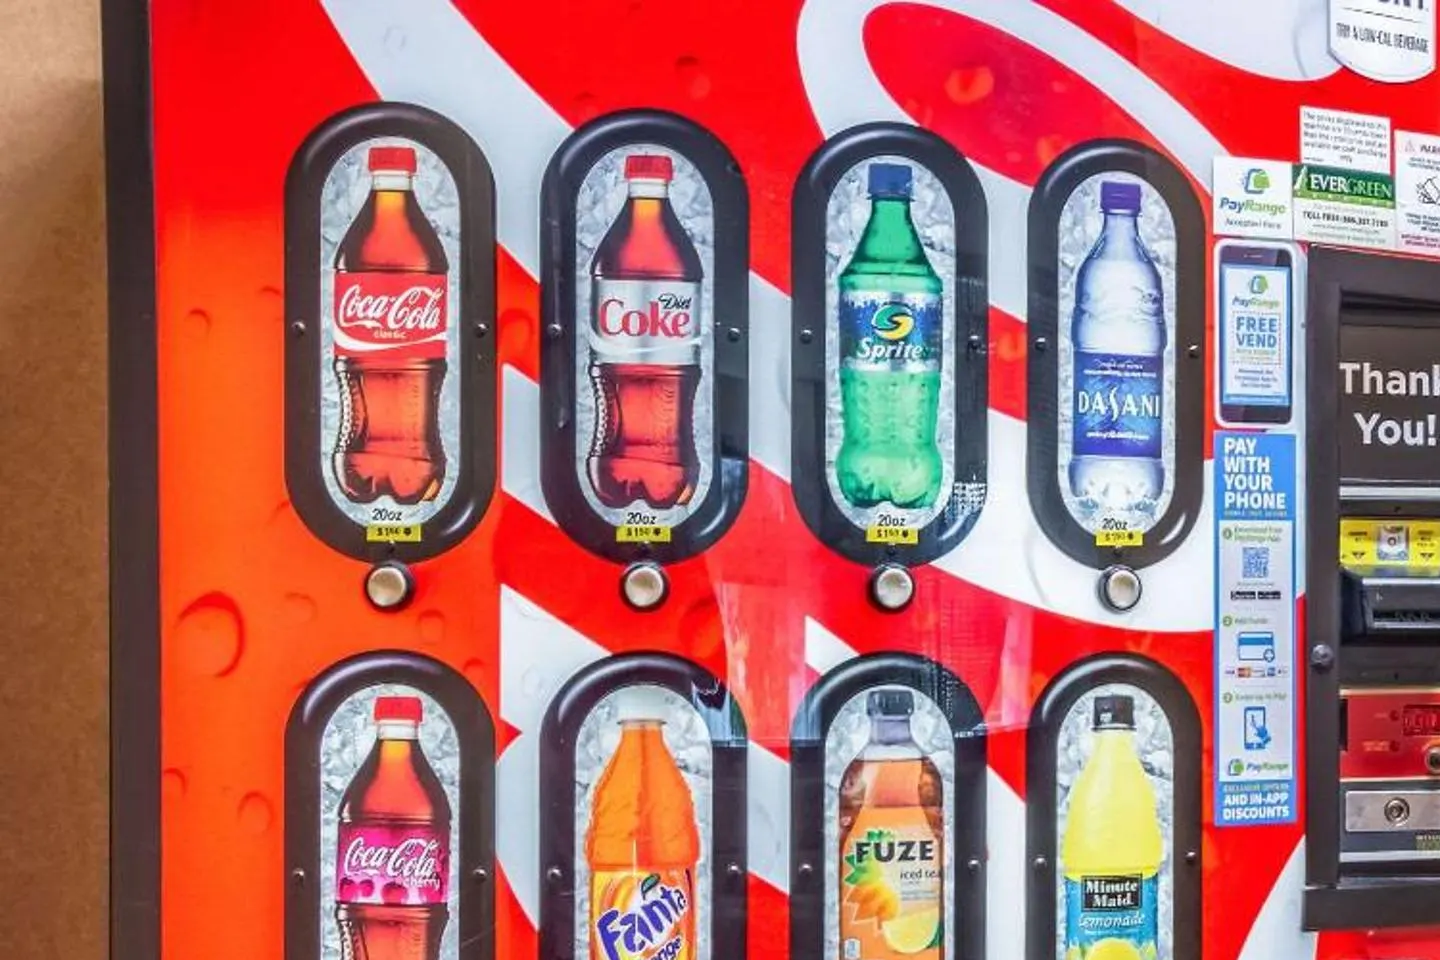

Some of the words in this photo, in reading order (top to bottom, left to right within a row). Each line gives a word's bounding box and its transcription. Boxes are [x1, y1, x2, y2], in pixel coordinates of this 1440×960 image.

[1393, 34, 1429, 53] BEVERAGE
[1310, 173, 1392, 198] EVERGREEN
[1219, 196, 1286, 215] PayRange
[339, 284, 444, 329] Coca-Cola
[658, 292, 692, 310] Diet
[598, 298, 691, 338] Coke
[1236, 315, 1278, 333] FREE
[856, 337, 924, 362] Sprite
[1236, 332, 1278, 349] VEND
[1078, 386, 1160, 421] DASANI
[1353, 413, 1438, 447] You!
[1223, 436, 1257, 455] PAY
[1223, 455, 1271, 474] WITH
[1223, 473, 1274, 492] YOUR
[1224, 491, 1287, 510] PHONE
[627, 511, 657, 525] 20oz
[877, 513, 907, 526] 20oz
[1224, 793, 1248, 806] AND
[1223, 806, 1290, 820] DISCOUNTS
[855, 840, 934, 862] FUZE
[1086, 880, 1138, 894] Minute
[1092, 893, 1135, 907] Maid
